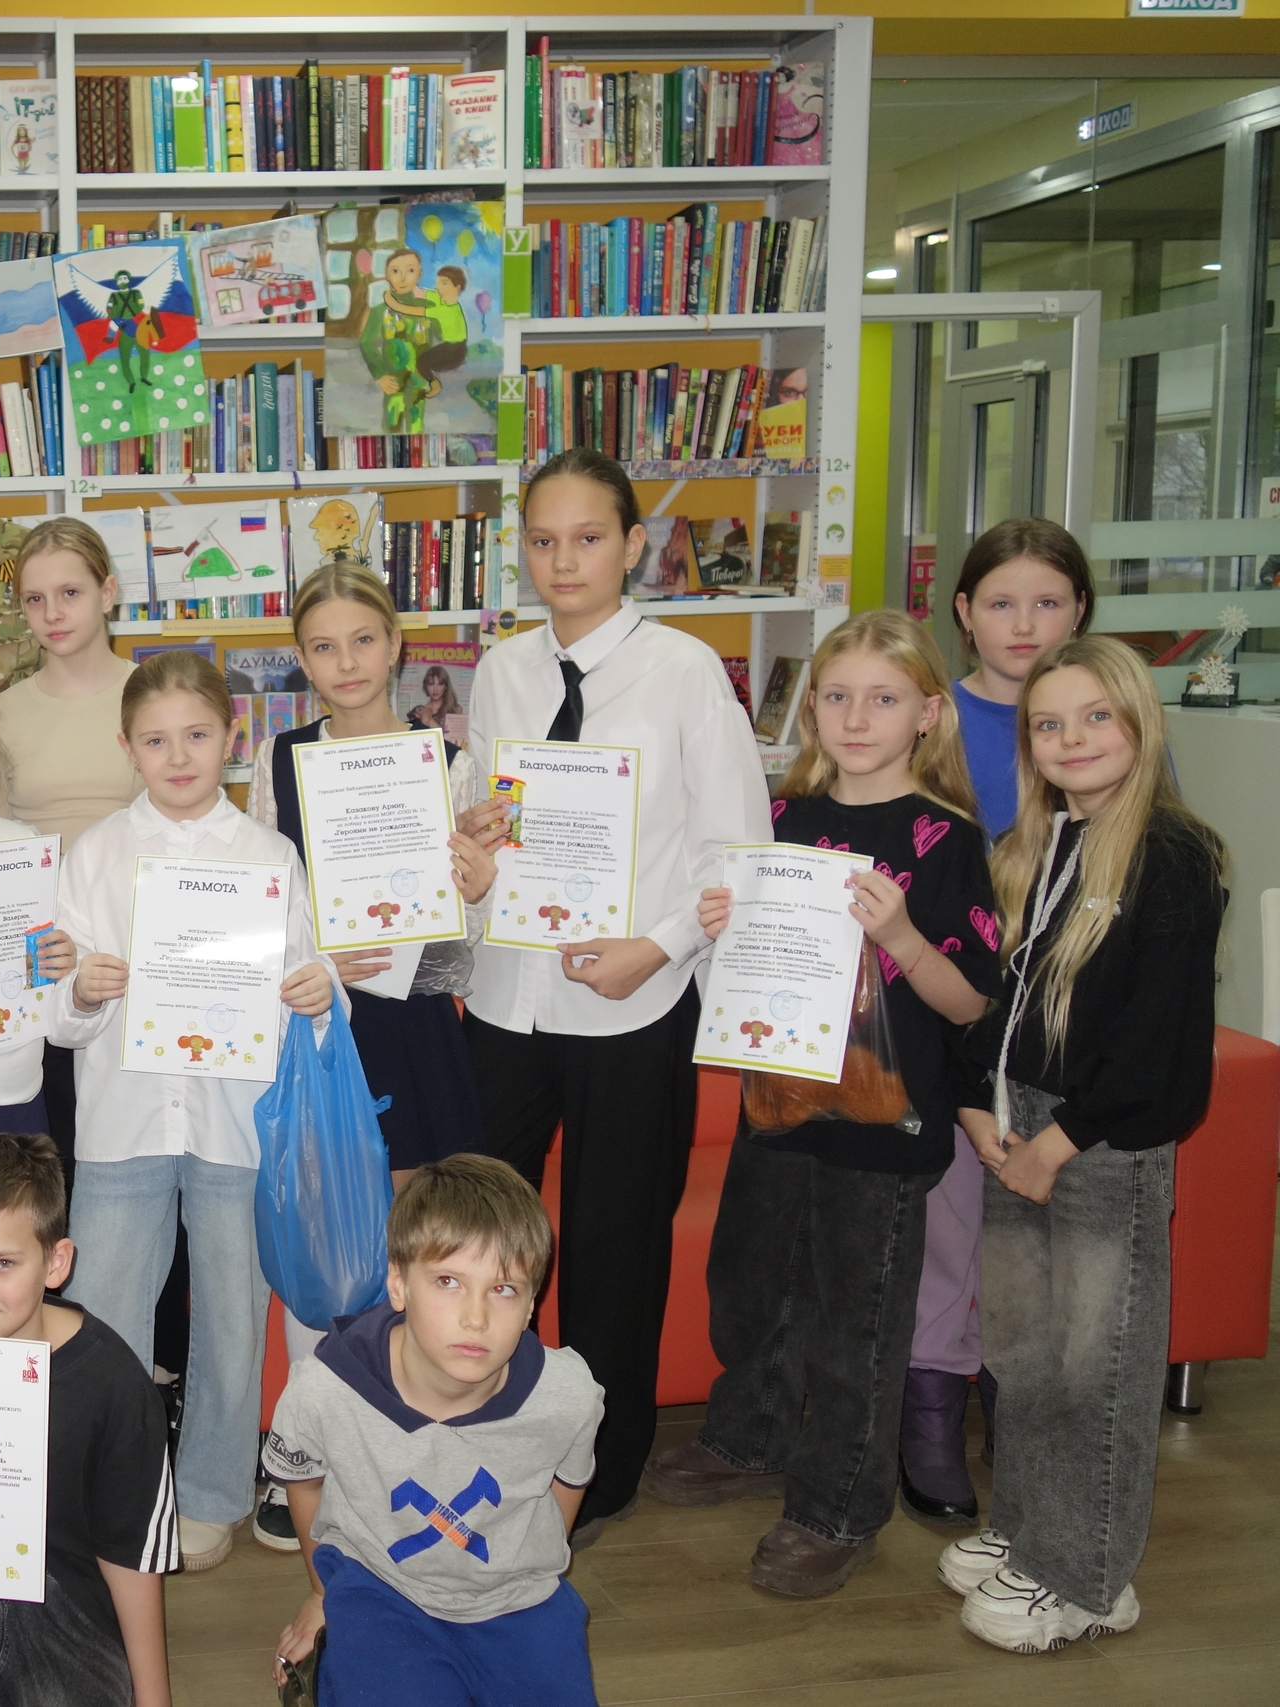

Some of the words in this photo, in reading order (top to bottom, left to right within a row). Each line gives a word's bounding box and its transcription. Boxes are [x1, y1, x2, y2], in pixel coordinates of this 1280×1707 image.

[449, 94, 498, 107] СКАЗАНИЕ
[464, 104, 492, 114] КИШЕ
[1083, 104, 1131, 140] ВЫХОД
[507, 229, 527, 251] У
[502, 378, 522, 398] Х
[826, 459, 851, 472] 12+
[70, 479, 98, 494] 12+
[239, 651, 299, 669] ДУМАЙ
[341, 757, 396, 770] ГРАМОТА
[520, 760, 608, 773] Благодарность
[756, 867, 813, 880] ГРАМОТА
[179, 880, 238, 893] ГРАМОТА
